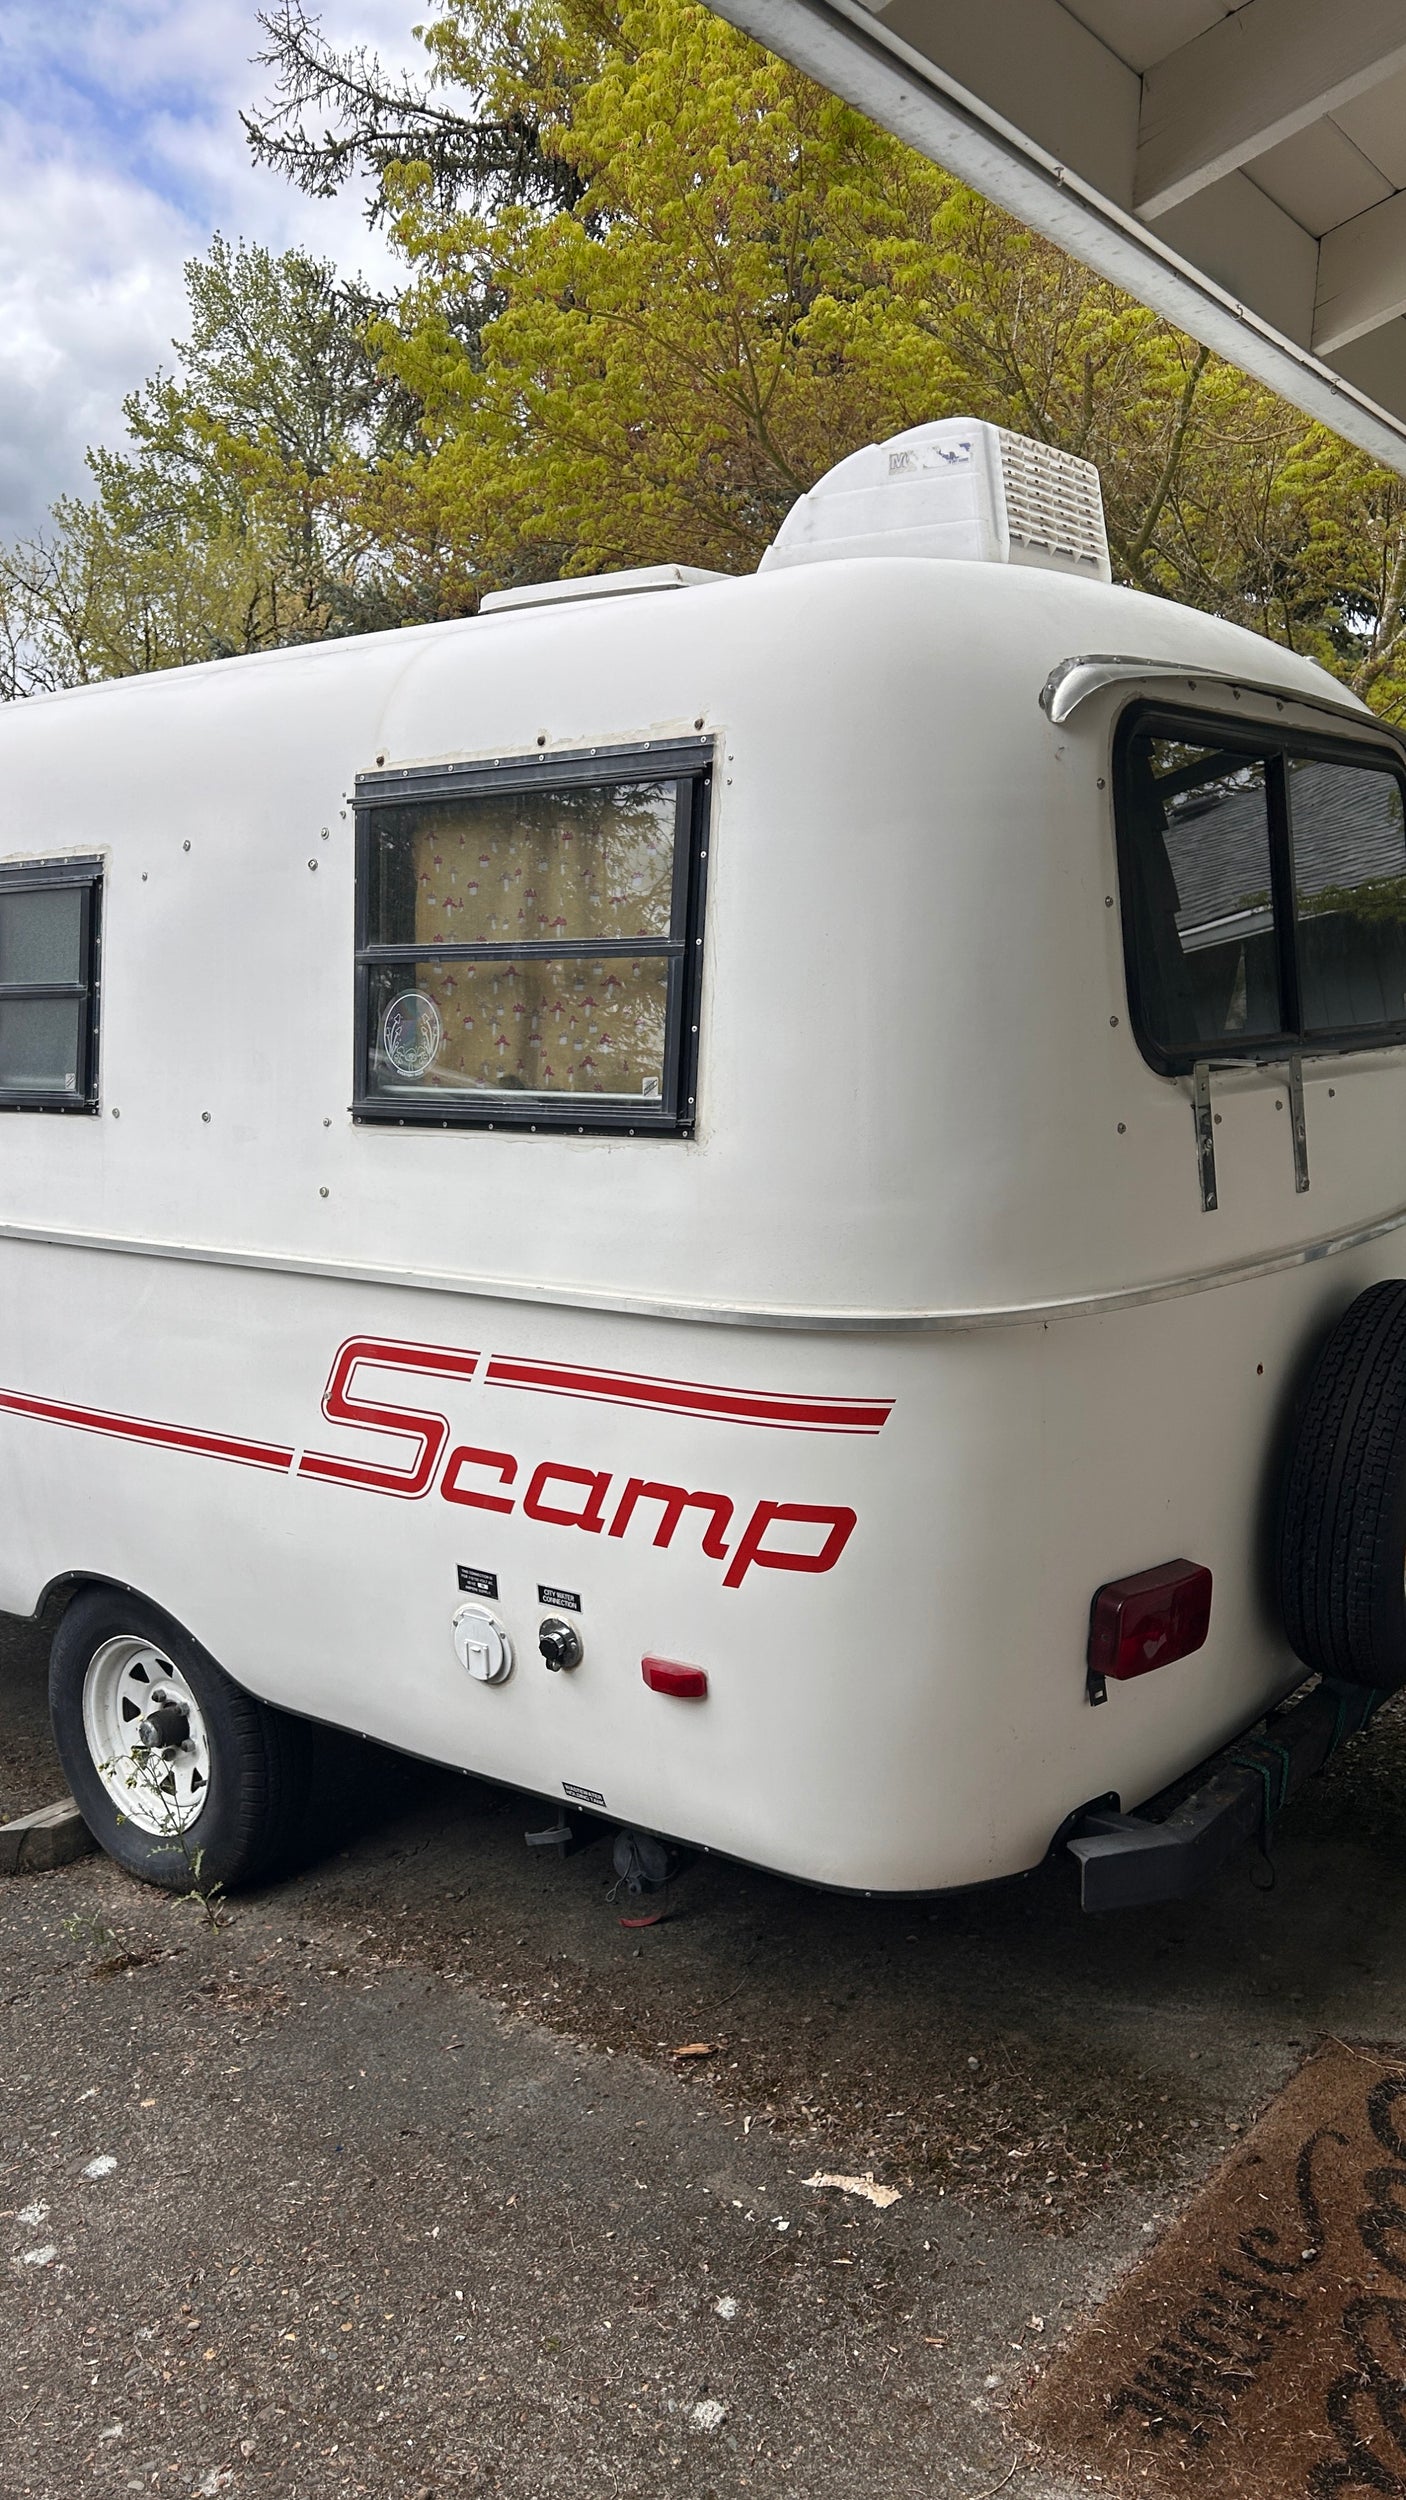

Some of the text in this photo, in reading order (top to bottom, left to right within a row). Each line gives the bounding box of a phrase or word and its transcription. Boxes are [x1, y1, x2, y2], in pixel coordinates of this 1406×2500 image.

[297, 1335, 857, 1588] Scamp
[543, 1588, 575, 1601] CITY WATER
[542, 1595, 577, 1609] CONNECTION
